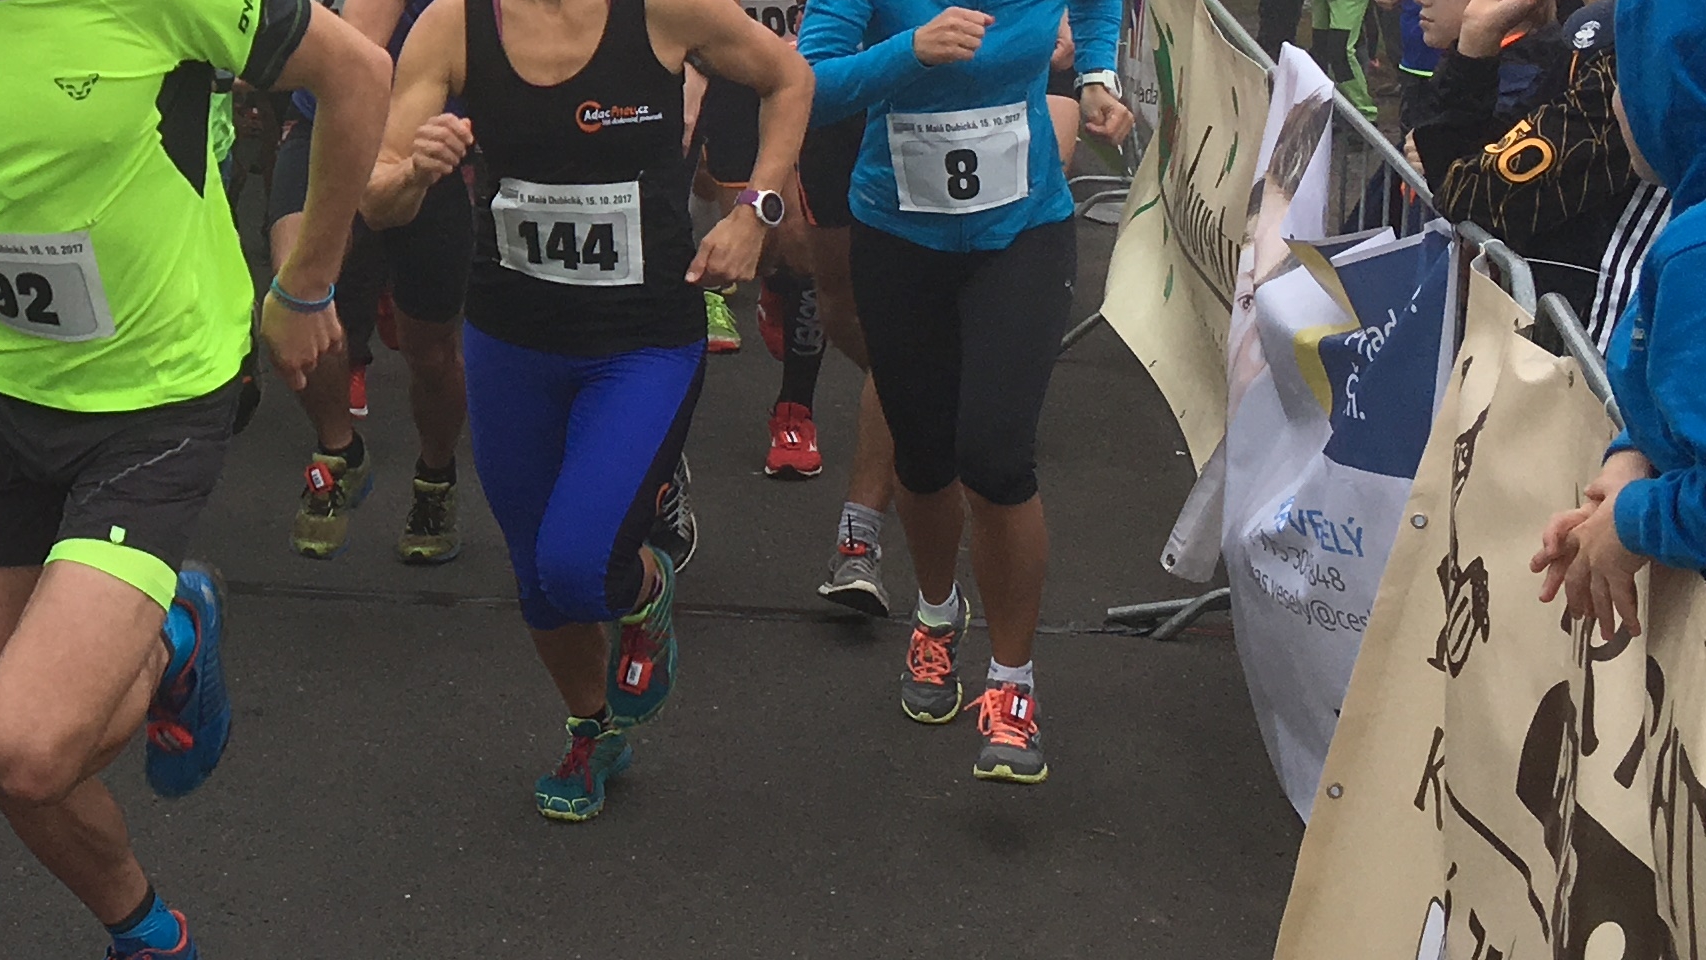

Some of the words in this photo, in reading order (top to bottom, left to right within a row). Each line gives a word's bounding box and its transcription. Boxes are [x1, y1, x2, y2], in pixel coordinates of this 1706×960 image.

[944, 148, 981, 201] 8
[612, 194, 633, 205] 2017
[60, 243, 83, 256] 2017
[517, 220, 620, 272] 144
